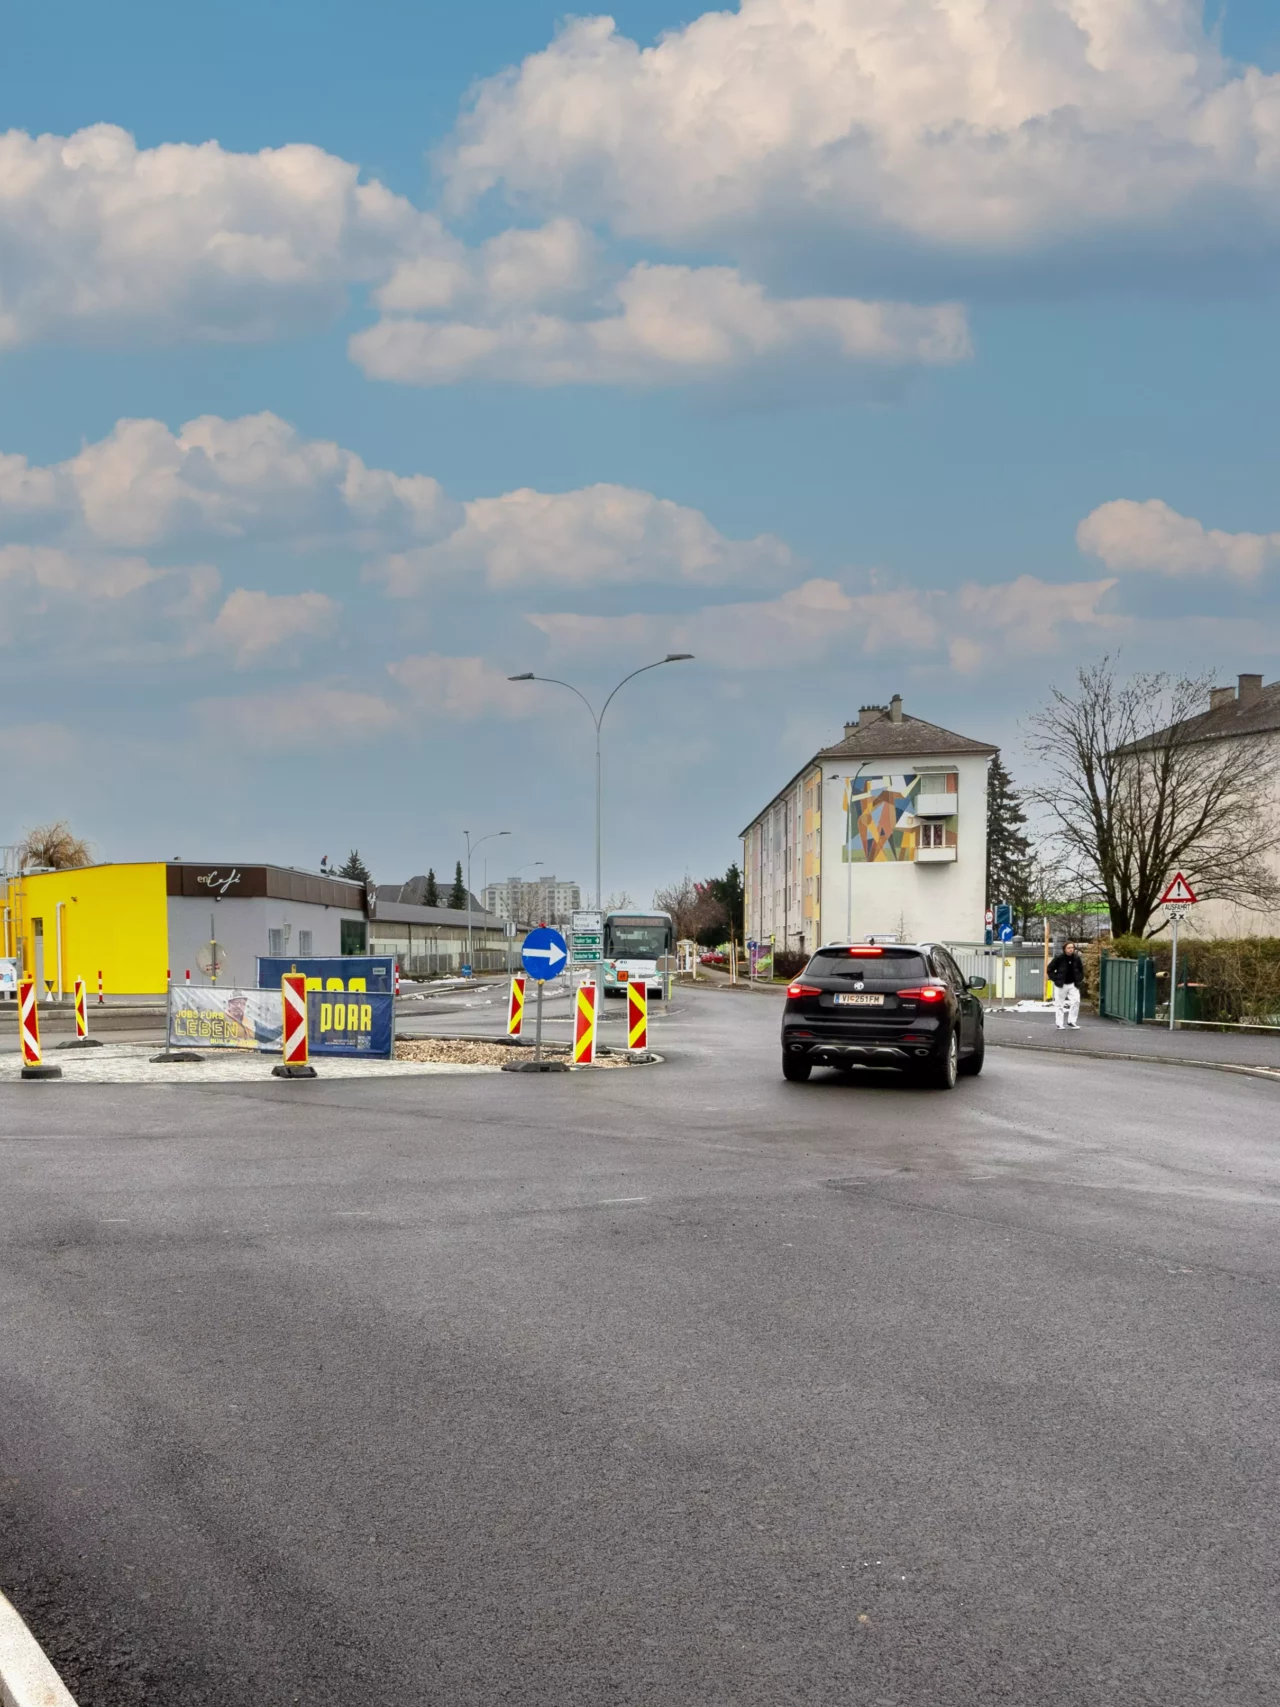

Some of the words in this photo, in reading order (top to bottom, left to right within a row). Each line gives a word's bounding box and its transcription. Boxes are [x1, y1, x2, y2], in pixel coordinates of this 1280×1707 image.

[176, 1010, 198, 1019] JOBS
[320, 1003, 372, 1032] PORR
[174, 1019, 239, 1038] LEBEN
